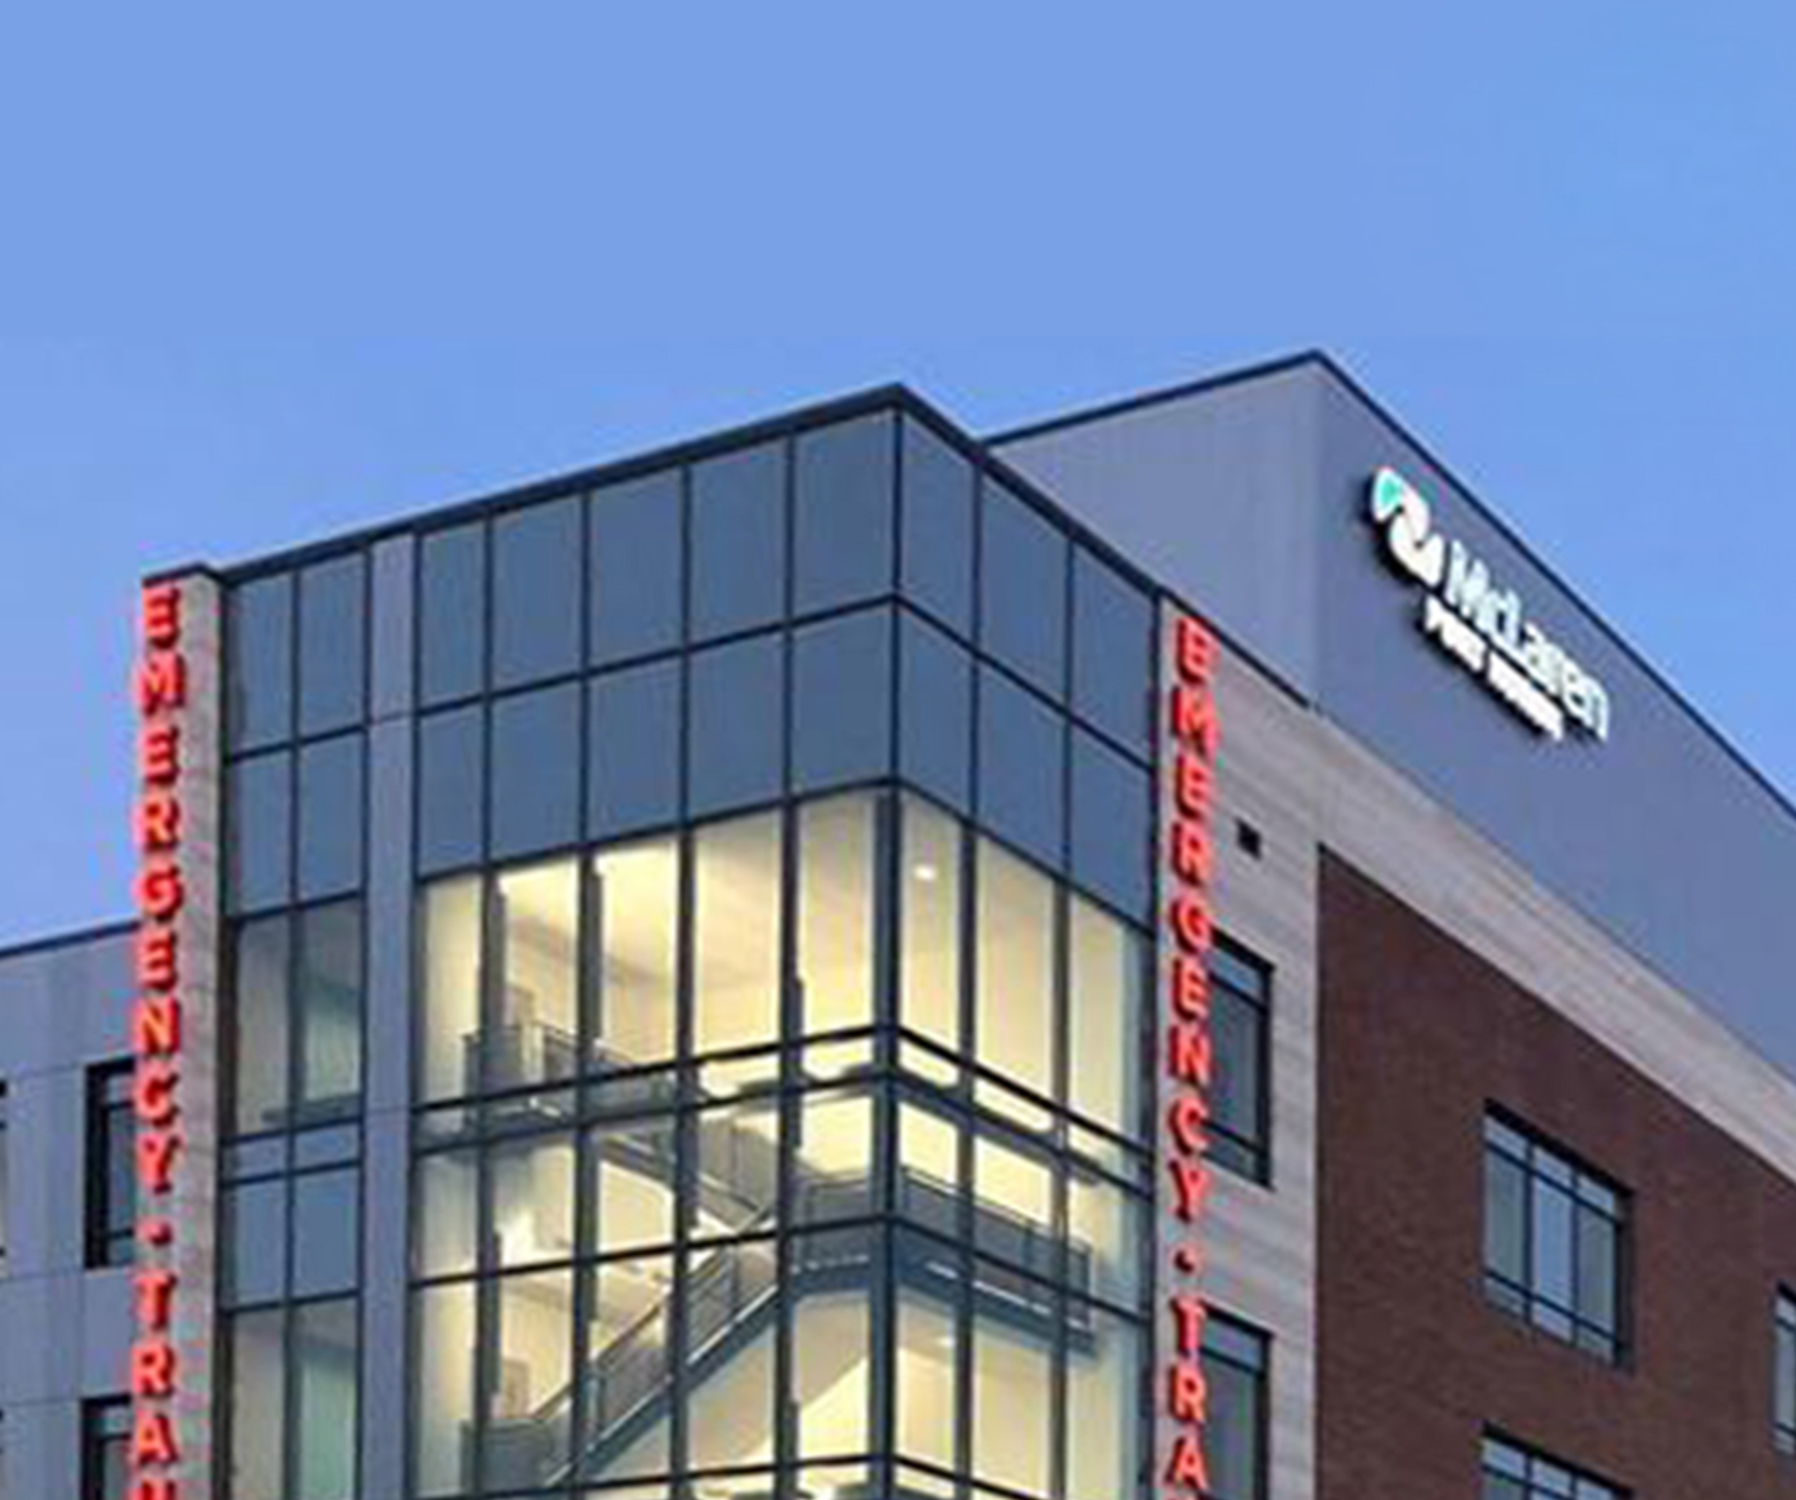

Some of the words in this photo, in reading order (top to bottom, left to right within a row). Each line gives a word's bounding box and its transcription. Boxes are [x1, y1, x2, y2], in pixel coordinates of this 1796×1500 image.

[134, 582, 187, 1196] EMERGENCY
[1166, 614, 1219, 1224] EMERGENCY
[1444, 538, 1609, 742] McLaren
